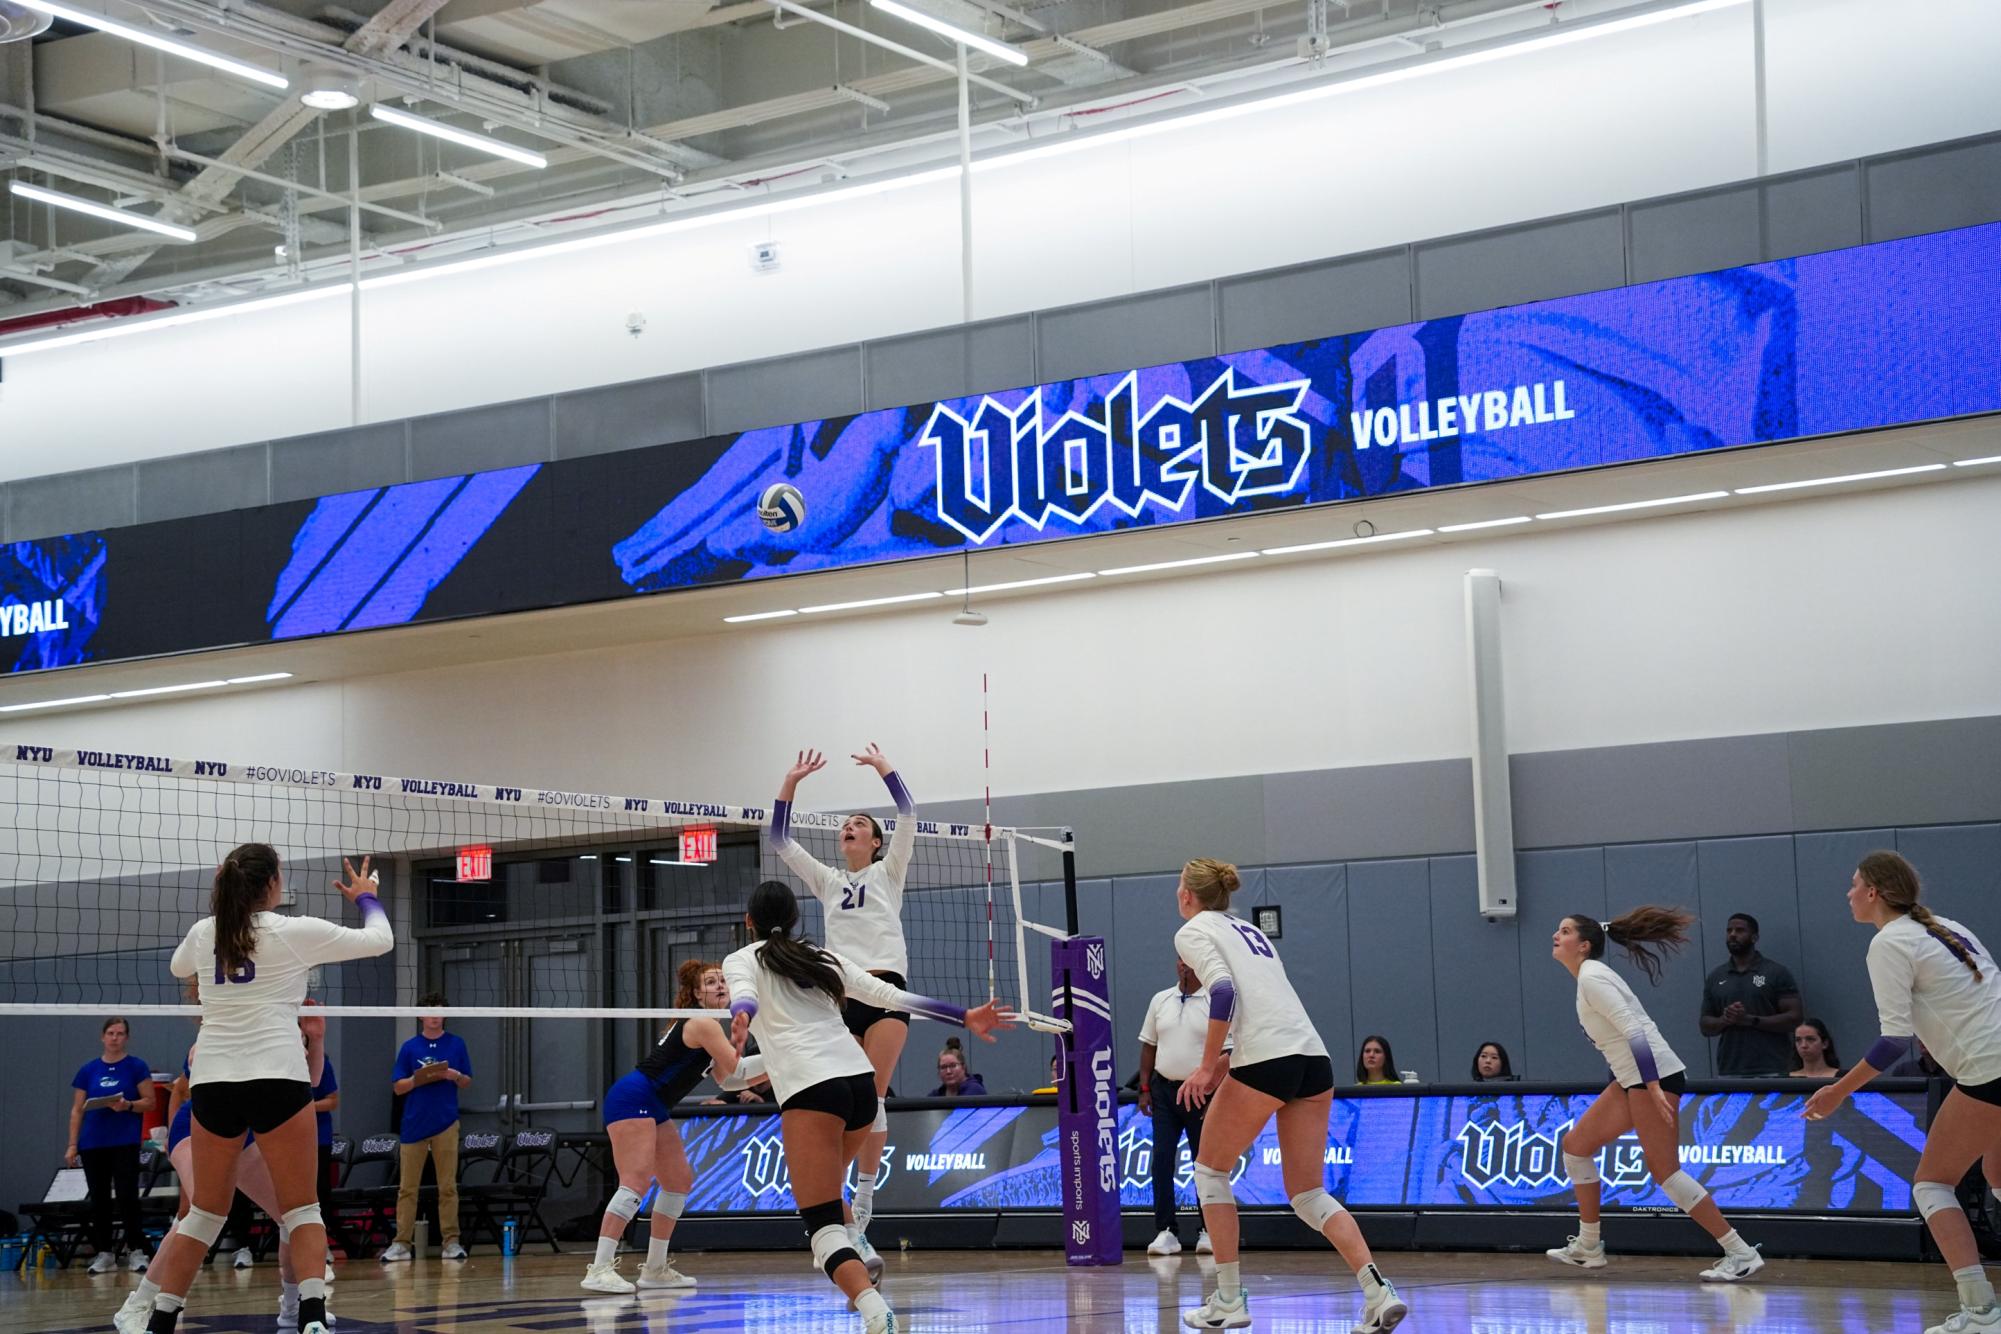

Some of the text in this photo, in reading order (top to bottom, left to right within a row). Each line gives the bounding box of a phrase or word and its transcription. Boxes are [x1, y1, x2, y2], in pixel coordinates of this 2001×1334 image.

[918, 366, 1575, 545] Violets VOLLEYBALL
[16, 745, 969, 836] NYU VOLLEYBALL NYU #GOVIOLETS NYU VOLLEYBALL NYU #GOVIOLETS NYU VOLLEYBALL NYU OVIOLETS VOBALL NYU
[683, 831, 712, 860] EXIT
[841, 884, 866, 910] 21
[1231, 923, 1274, 959] 13
[1091, 1044, 1116, 1192] Violets
[906, 1153, 986, 1171] VOLLEYBALL
[1070, 1130, 1083, 1211] sports imports
[1677, 1145, 1786, 1164] VOLLEYBALL
